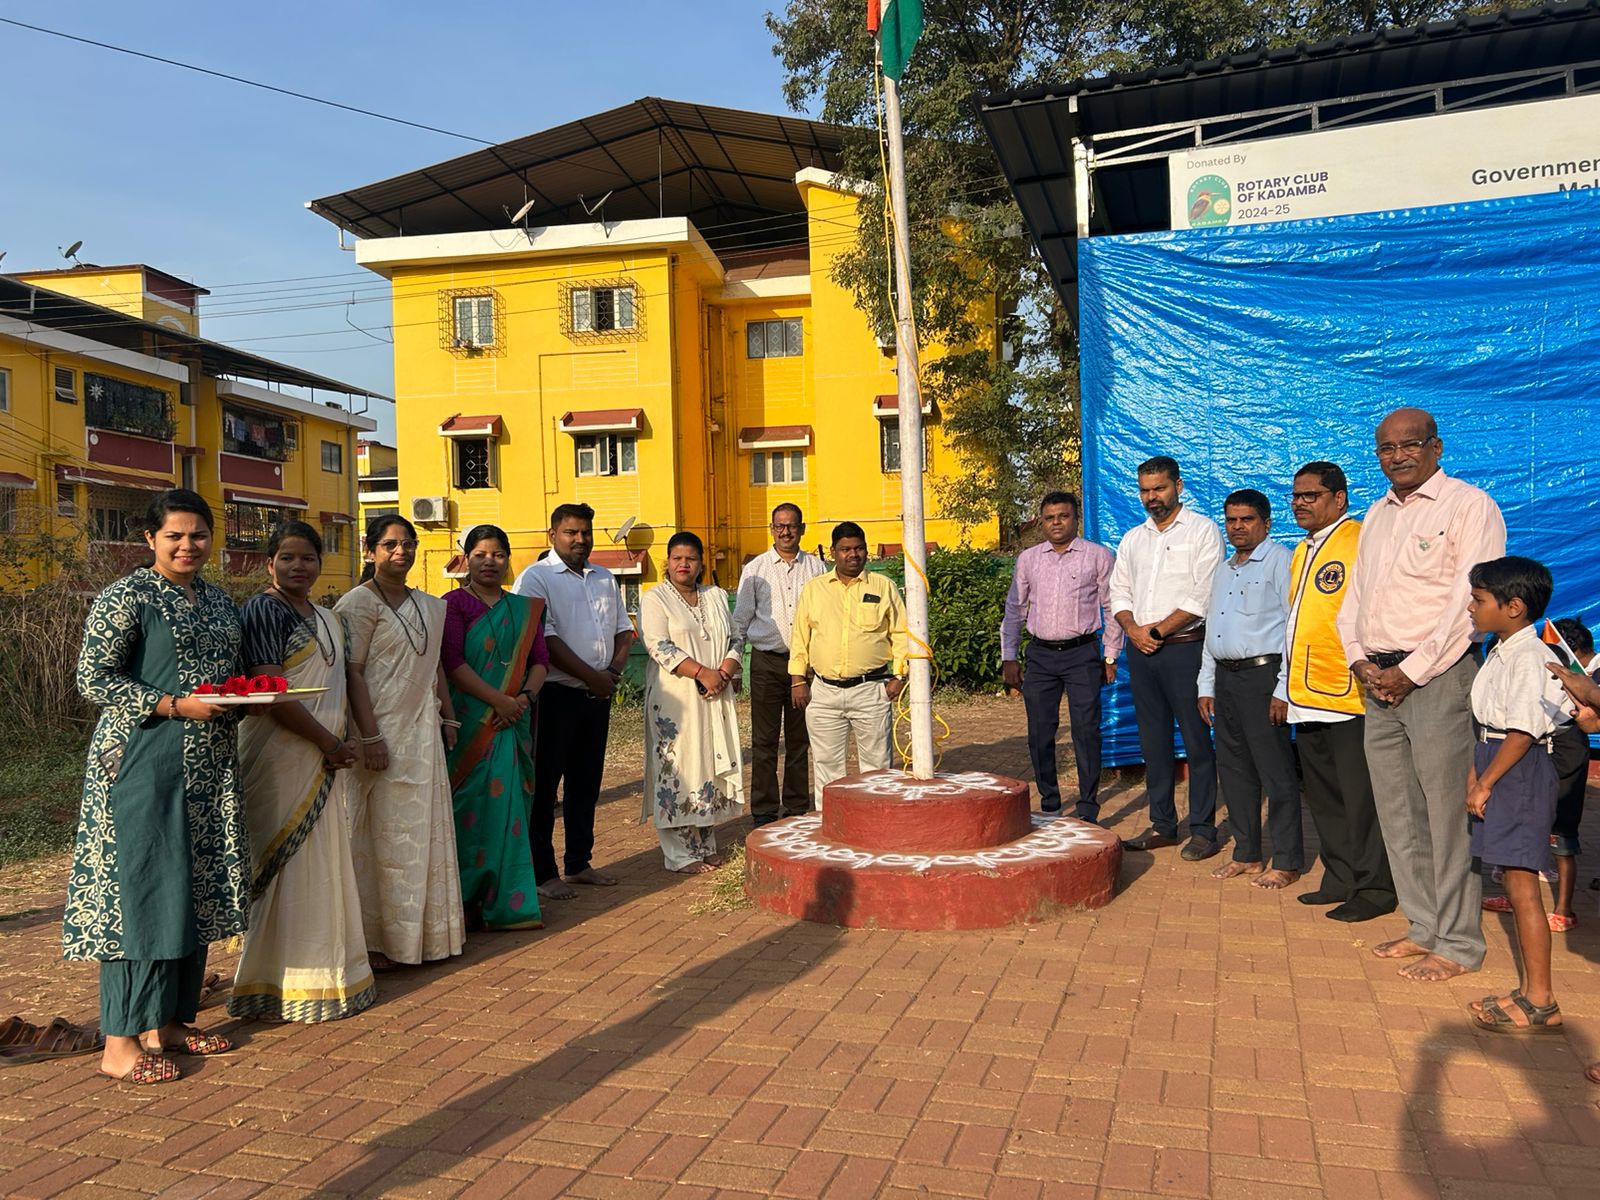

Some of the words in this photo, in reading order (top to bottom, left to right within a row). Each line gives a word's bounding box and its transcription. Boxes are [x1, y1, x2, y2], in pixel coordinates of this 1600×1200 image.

[1186, 155, 1231, 170] Donated
[1233, 154, 1247, 166] By
[1237, 176, 1290, 193] ROTARY
[1293, 171, 1329, 185] CLUB
[1237, 191, 1254, 203] OF
[1257, 183, 1327, 201] KADAMBA
[1237, 204, 1291, 220] 2024-25
